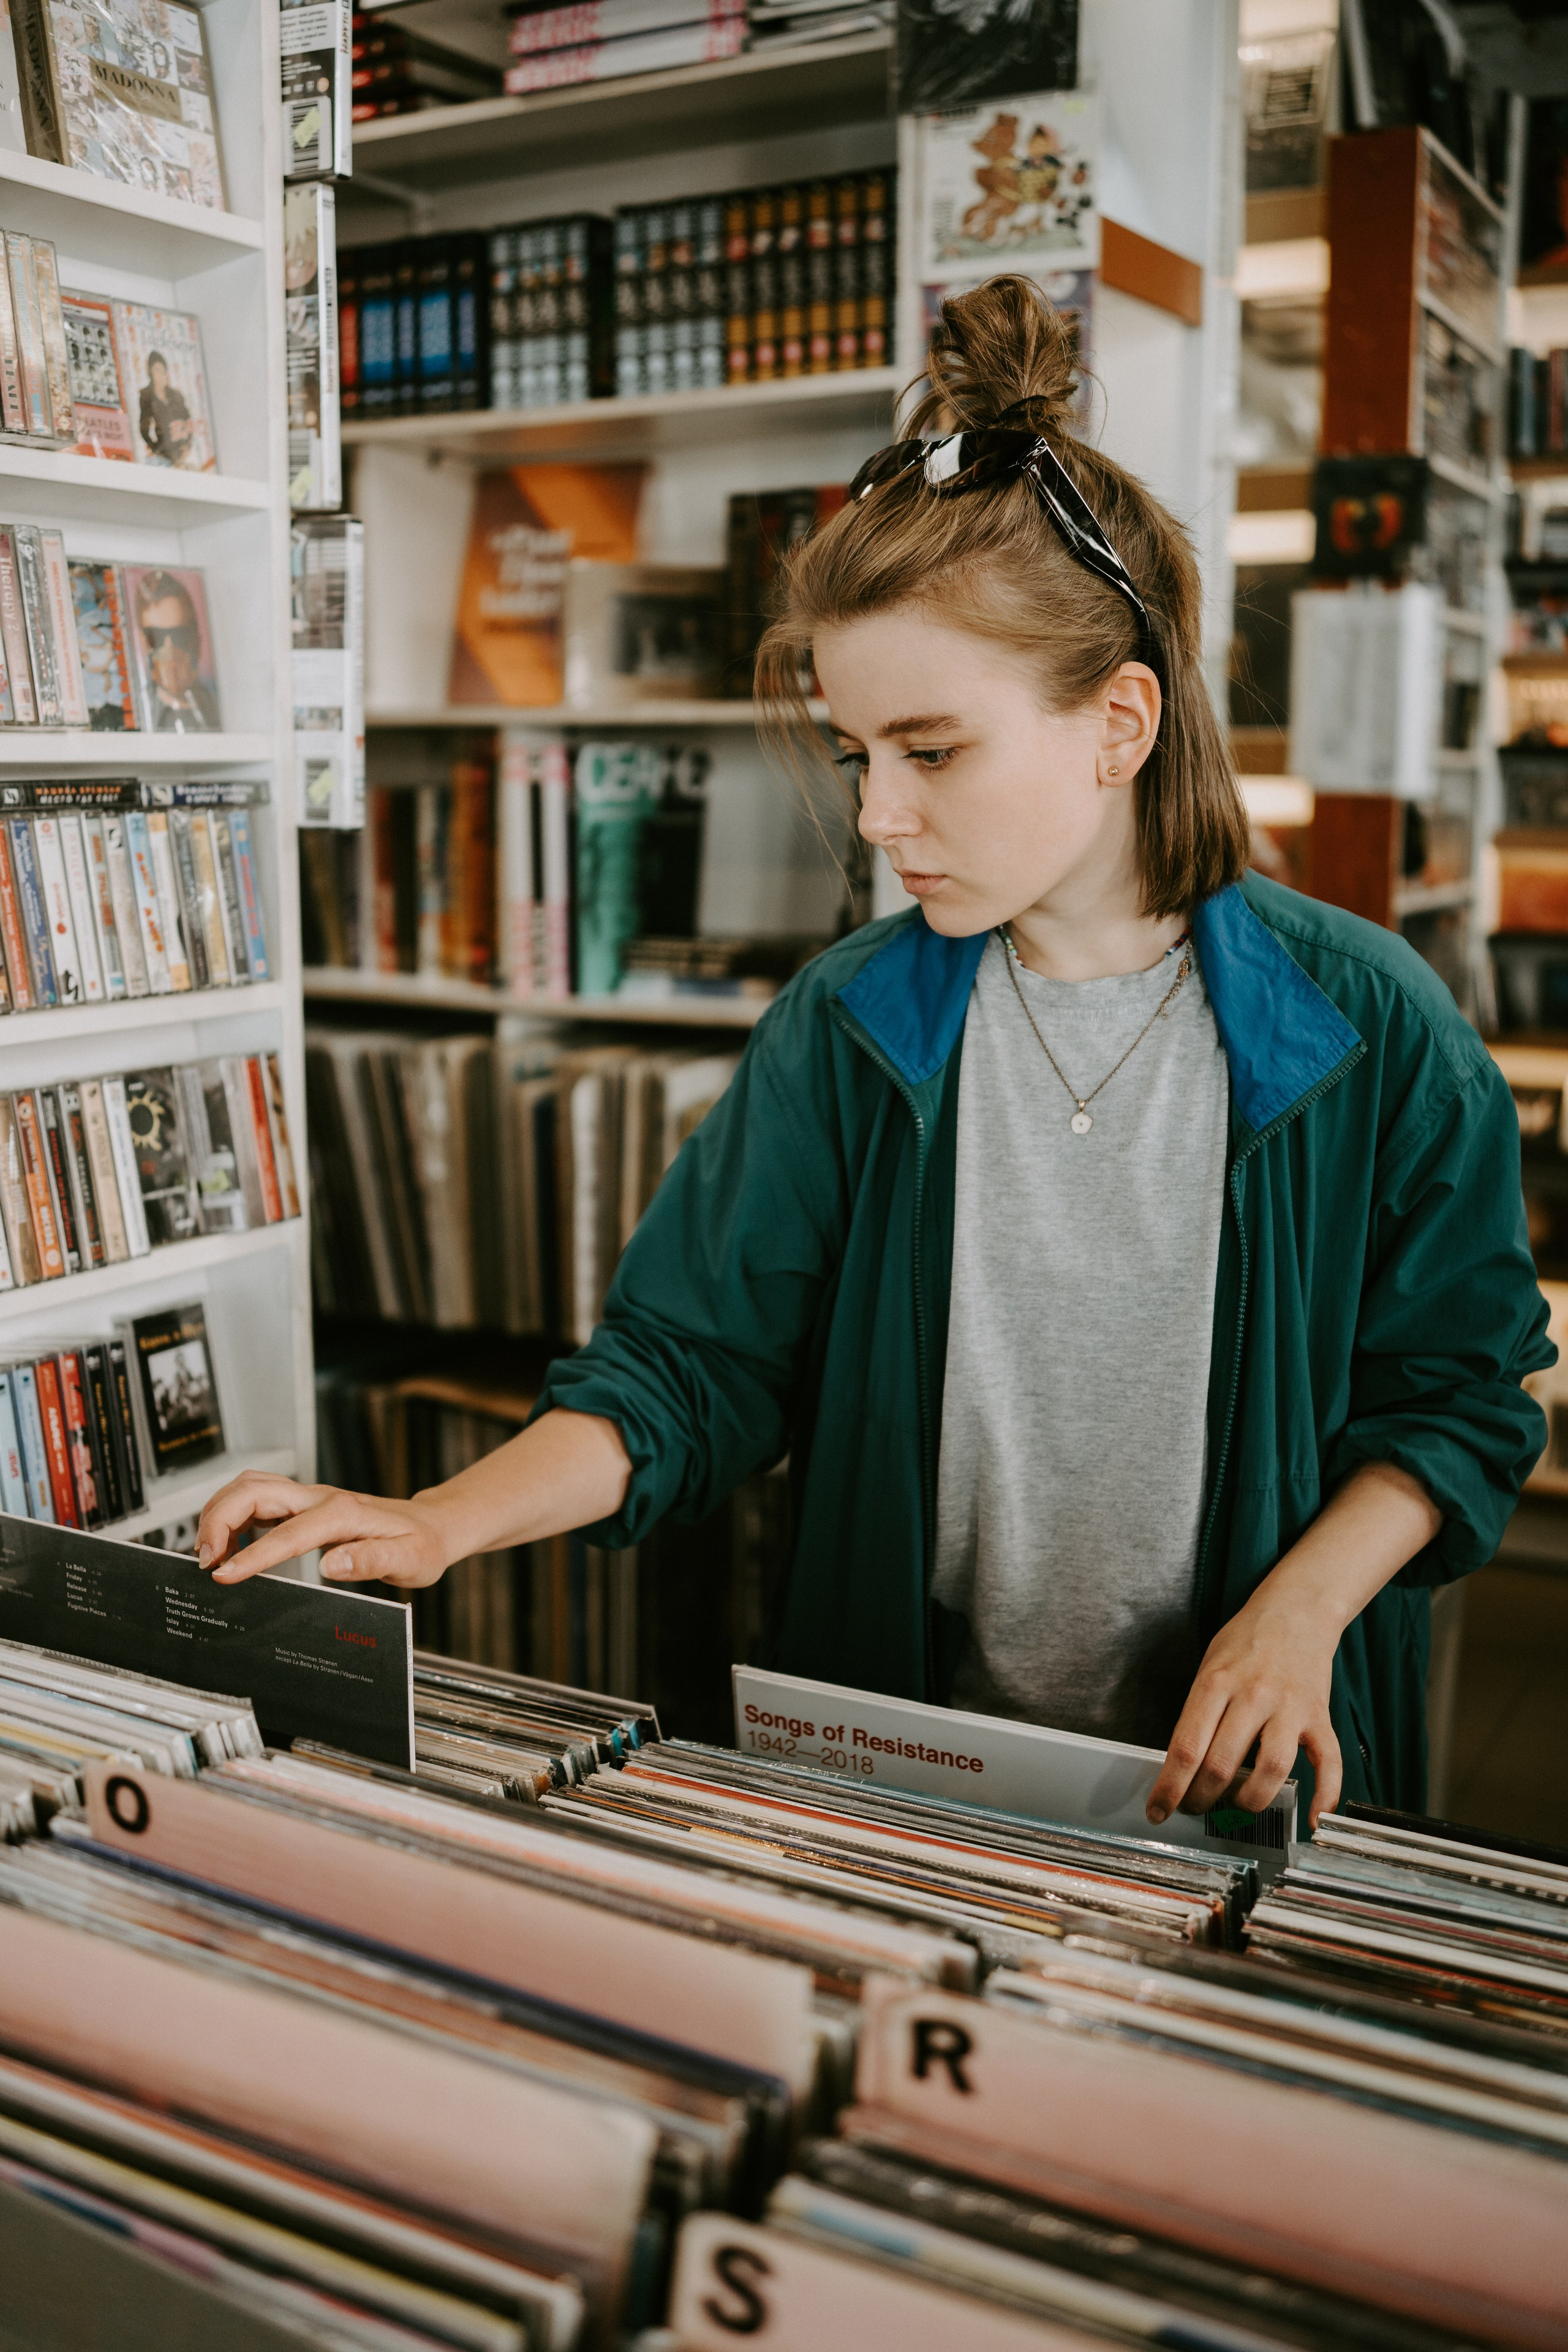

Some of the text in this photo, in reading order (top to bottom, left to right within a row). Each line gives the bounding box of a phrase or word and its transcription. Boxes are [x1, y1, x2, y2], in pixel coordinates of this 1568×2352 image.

[94, 64, 177, 104] MADONNA
[74, 1564, 86, 1573] Bella
[66, 1572, 83, 1582] Friday
[67, 1581, 87, 1593] Release
[165, 1586, 179, 1595] Baka
[67, 1592, 83, 1602] Lucus
[165, 1596, 198, 1611] Wednesday
[67, 1602, 88, 1612] Fugitive
[89, 1607, 107, 1617] Pieces
[165, 1607, 181, 1616] Truth
[181, 1610, 200, 1621] Grows
[201, 1616, 228, 1629] Gradually
[166, 1617, 179, 1627] Islay
[166, 1627, 193, 1639] Weekend
[335, 1625, 377, 1649] Lucus
[276, 1647, 290, 1656] Music
[298, 1653, 317, 1662] Thomas
[318, 1657, 338, 1667] Strønen
[276, 1655, 292, 1664] except
[300, 1660, 312, 1669] Bella
[744, 1703, 984, 1774] Songs of Resistance
[102, 1774, 152, 1834] O
[911, 2018, 975, 2095] R
[703, 2243, 775, 2336] S
